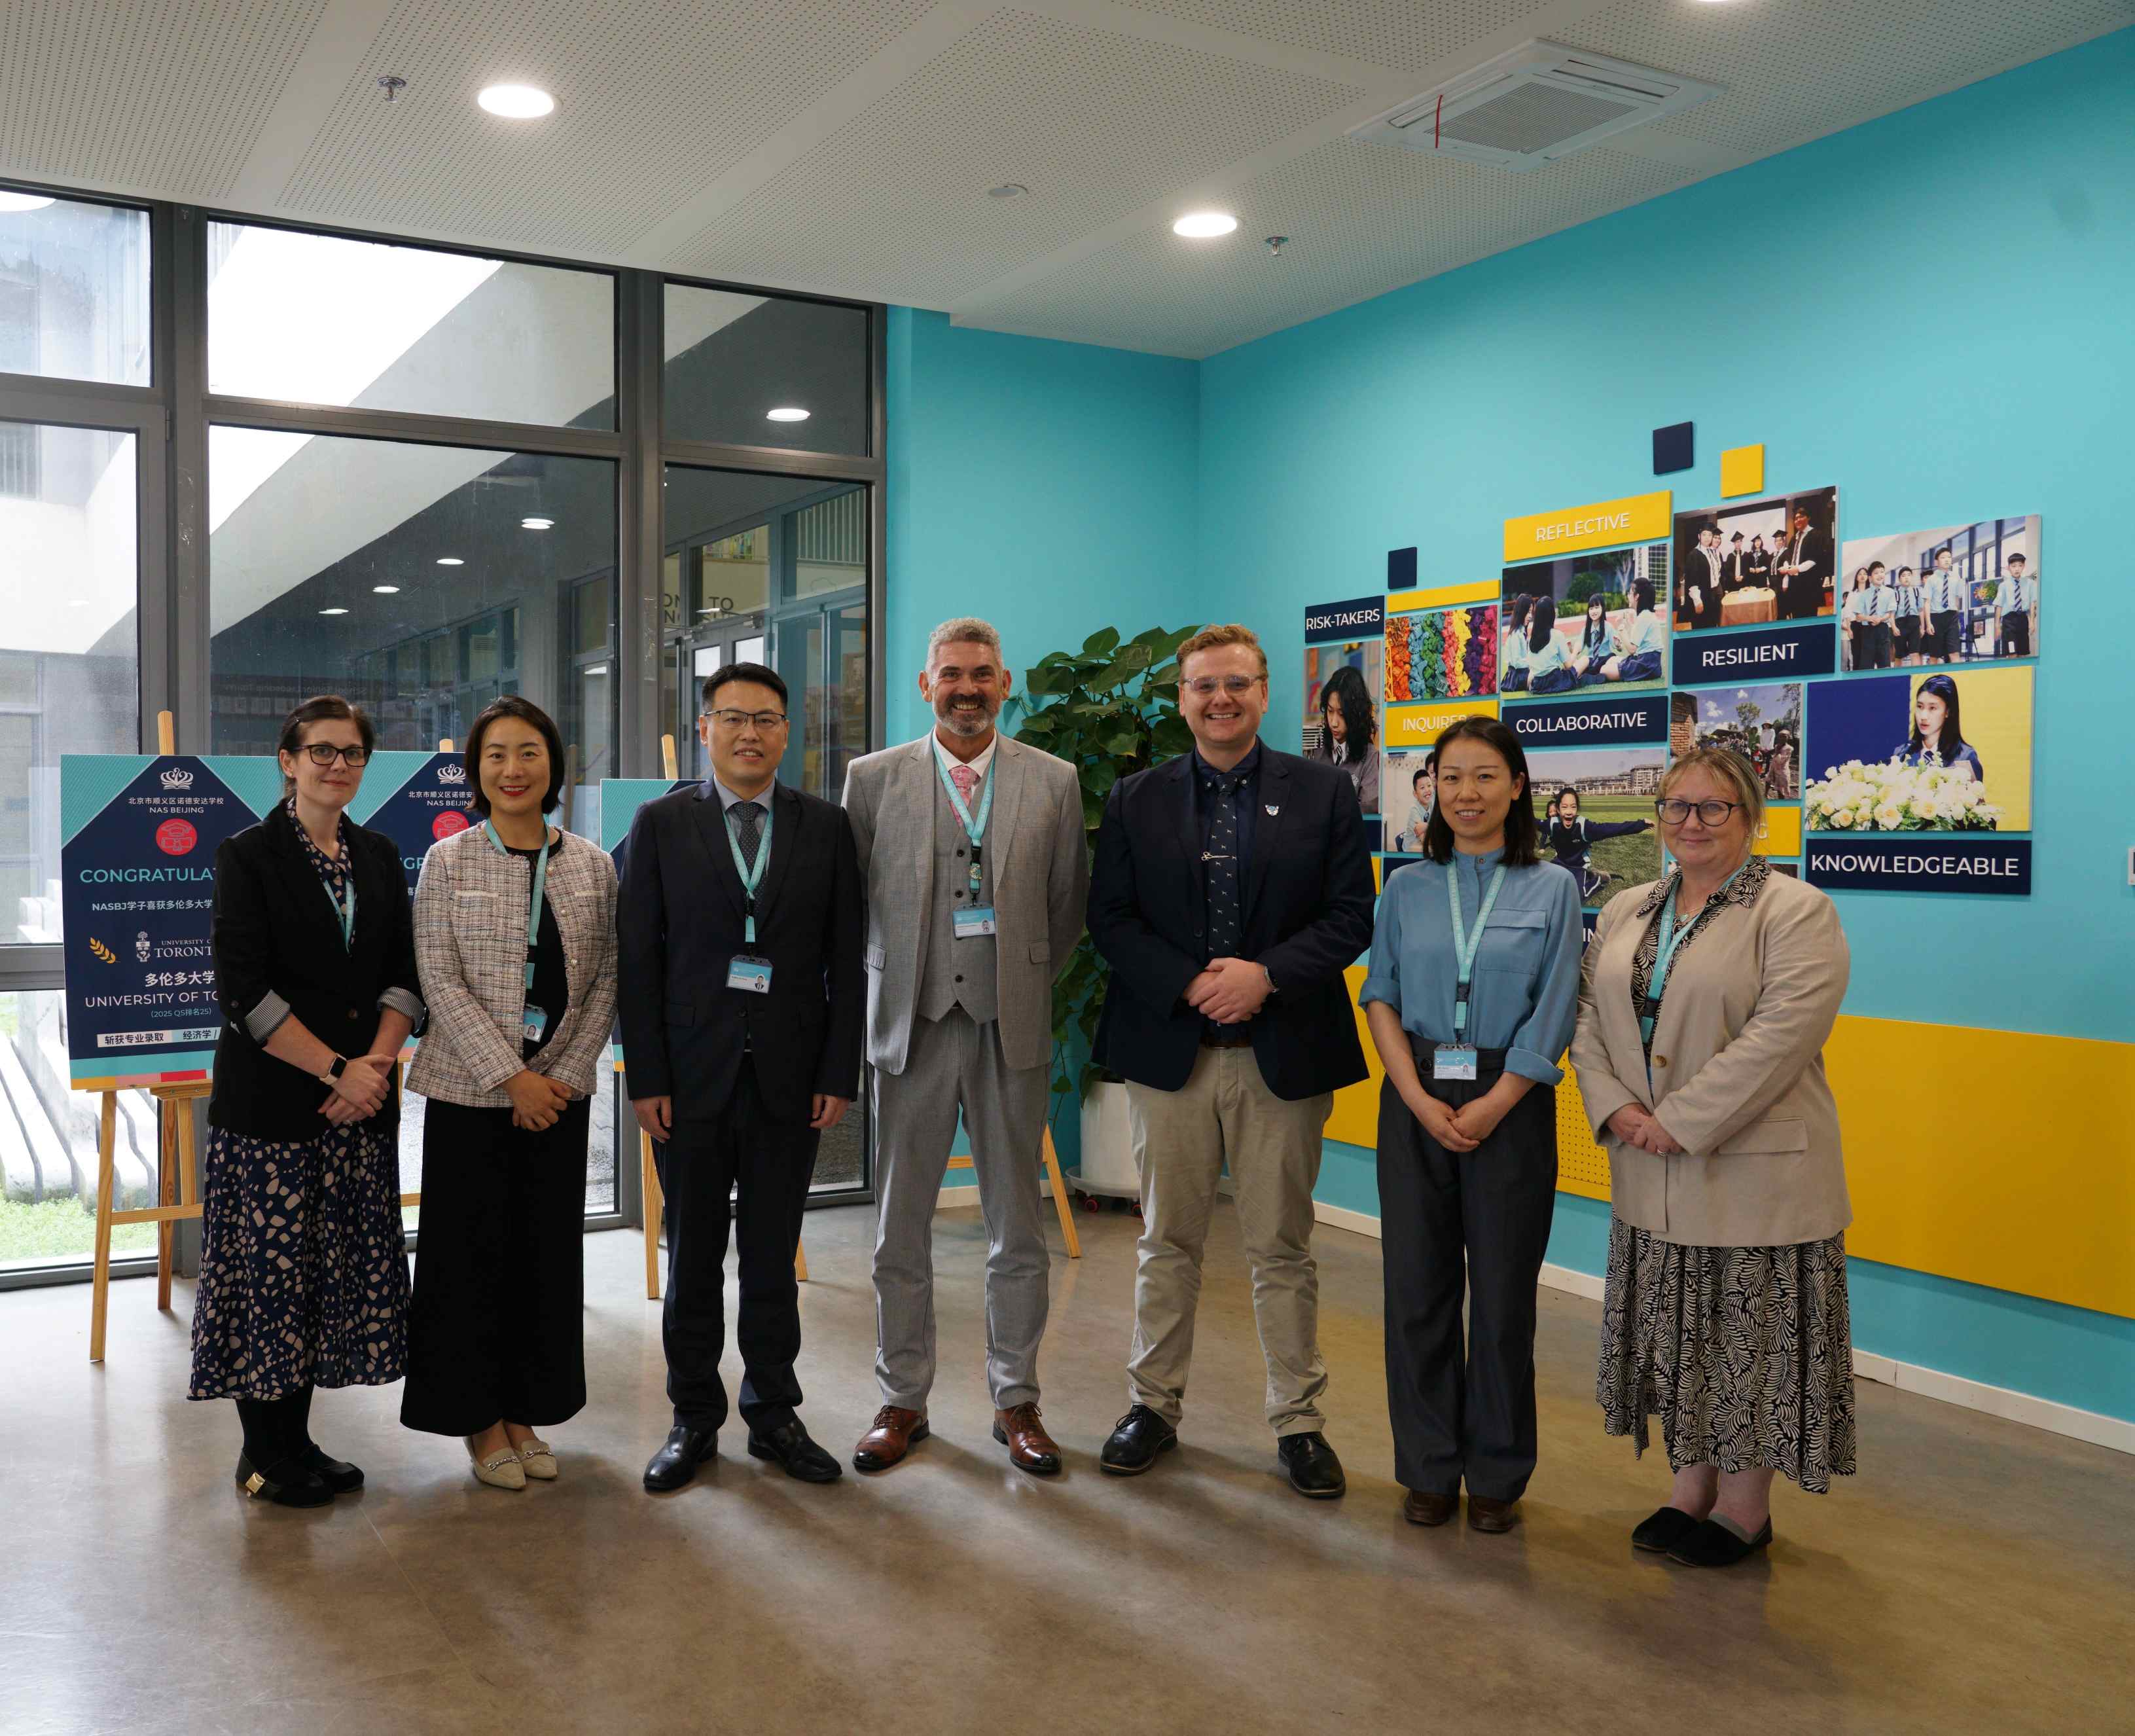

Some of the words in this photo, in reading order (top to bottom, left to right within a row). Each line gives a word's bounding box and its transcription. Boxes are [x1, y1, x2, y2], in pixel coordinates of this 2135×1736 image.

[1535, 513, 1630, 542] REFLECTIVE
[708, 596, 734, 611] TO
[1306, 608, 1380, 630] RISK-TAKERS
[1702, 643, 1799, 666] RESILIENT
[1516, 712, 1647, 733] COLLABORATIVE
[128, 797, 224, 805] 北京市顺义区诺德安达学校
[1811, 854, 2020, 877] KNOWLEDGEABLE
[80, 867, 217, 883] CONGRATULA
[154, 946, 213, 958] TORONT
[145, 970, 215, 987] 多伦多大学
[85, 992, 174, 1008] UNIVERSITY
[179, 992, 199, 1003] OF
[105, 1033, 164, 1045] 斩获专业录取
[183, 1029, 211, 1041] 经济学
